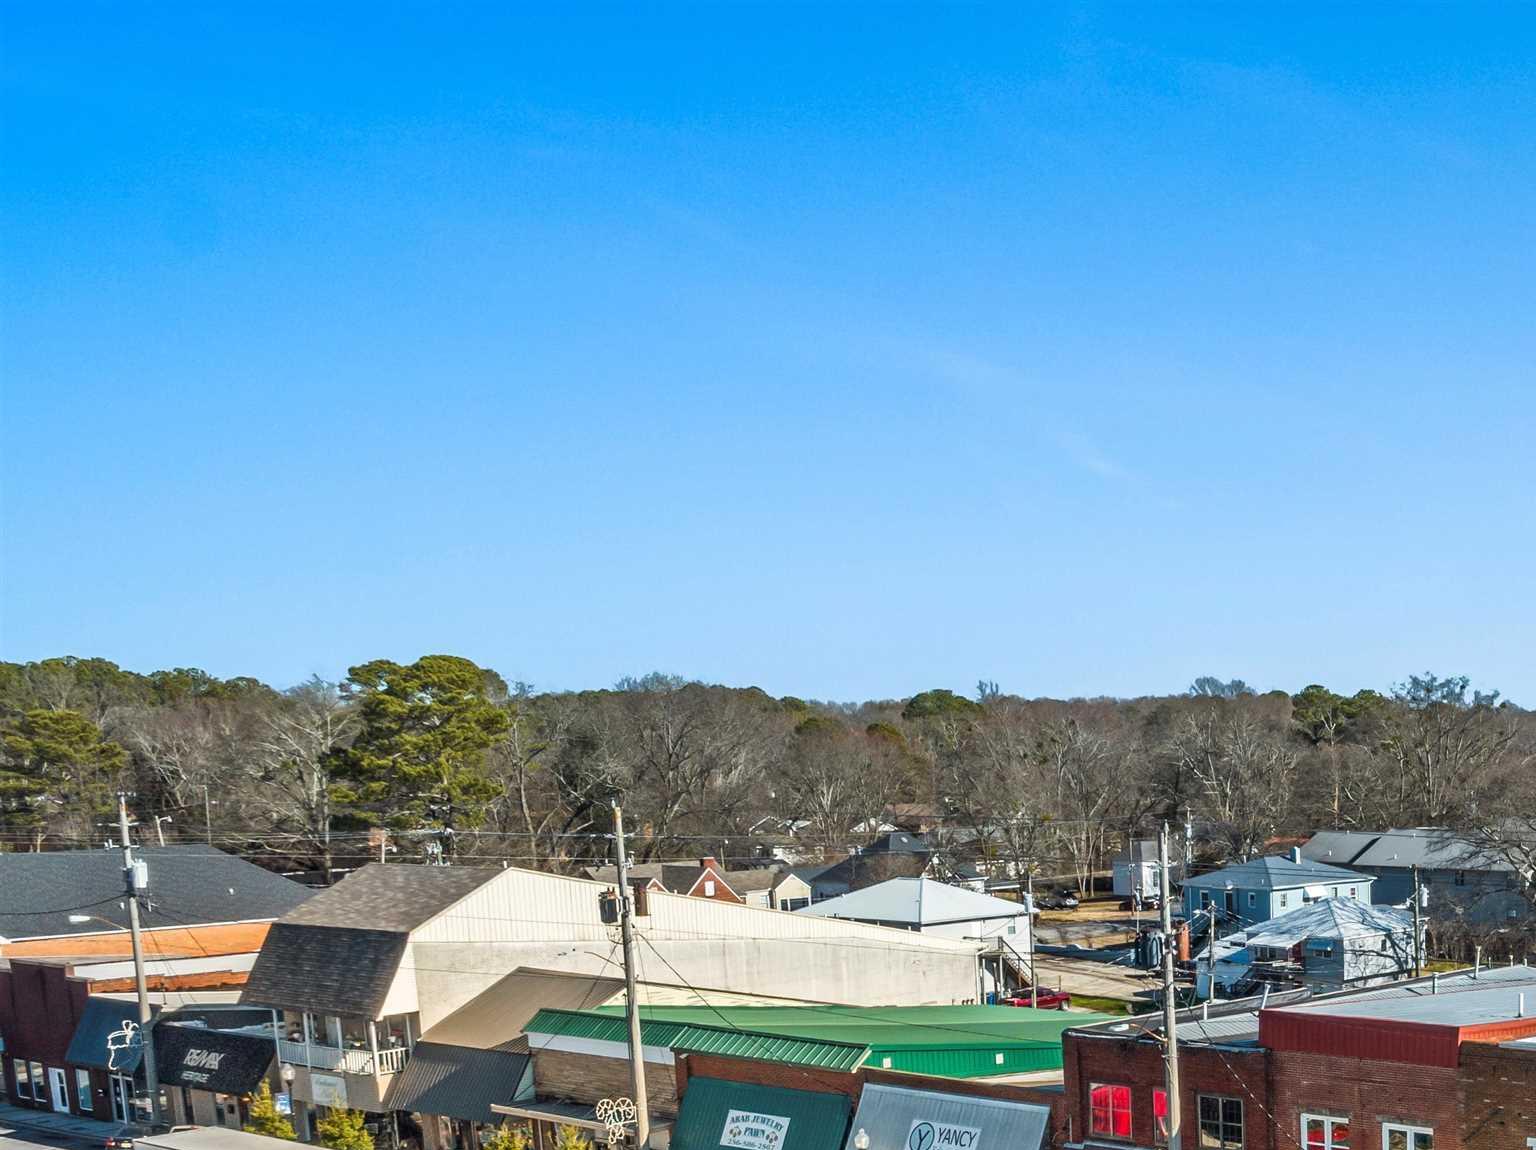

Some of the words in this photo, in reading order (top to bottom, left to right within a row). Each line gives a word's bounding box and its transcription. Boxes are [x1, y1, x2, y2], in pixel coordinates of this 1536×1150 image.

[729, 1114, 751, 1124] ARAB
[751, 1115, 784, 1132] JEWELRY
[743, 1126, 766, 1138] PAWN
[917, 1128, 930, 1150] Y
[937, 1127, 977, 1148] YANCY
